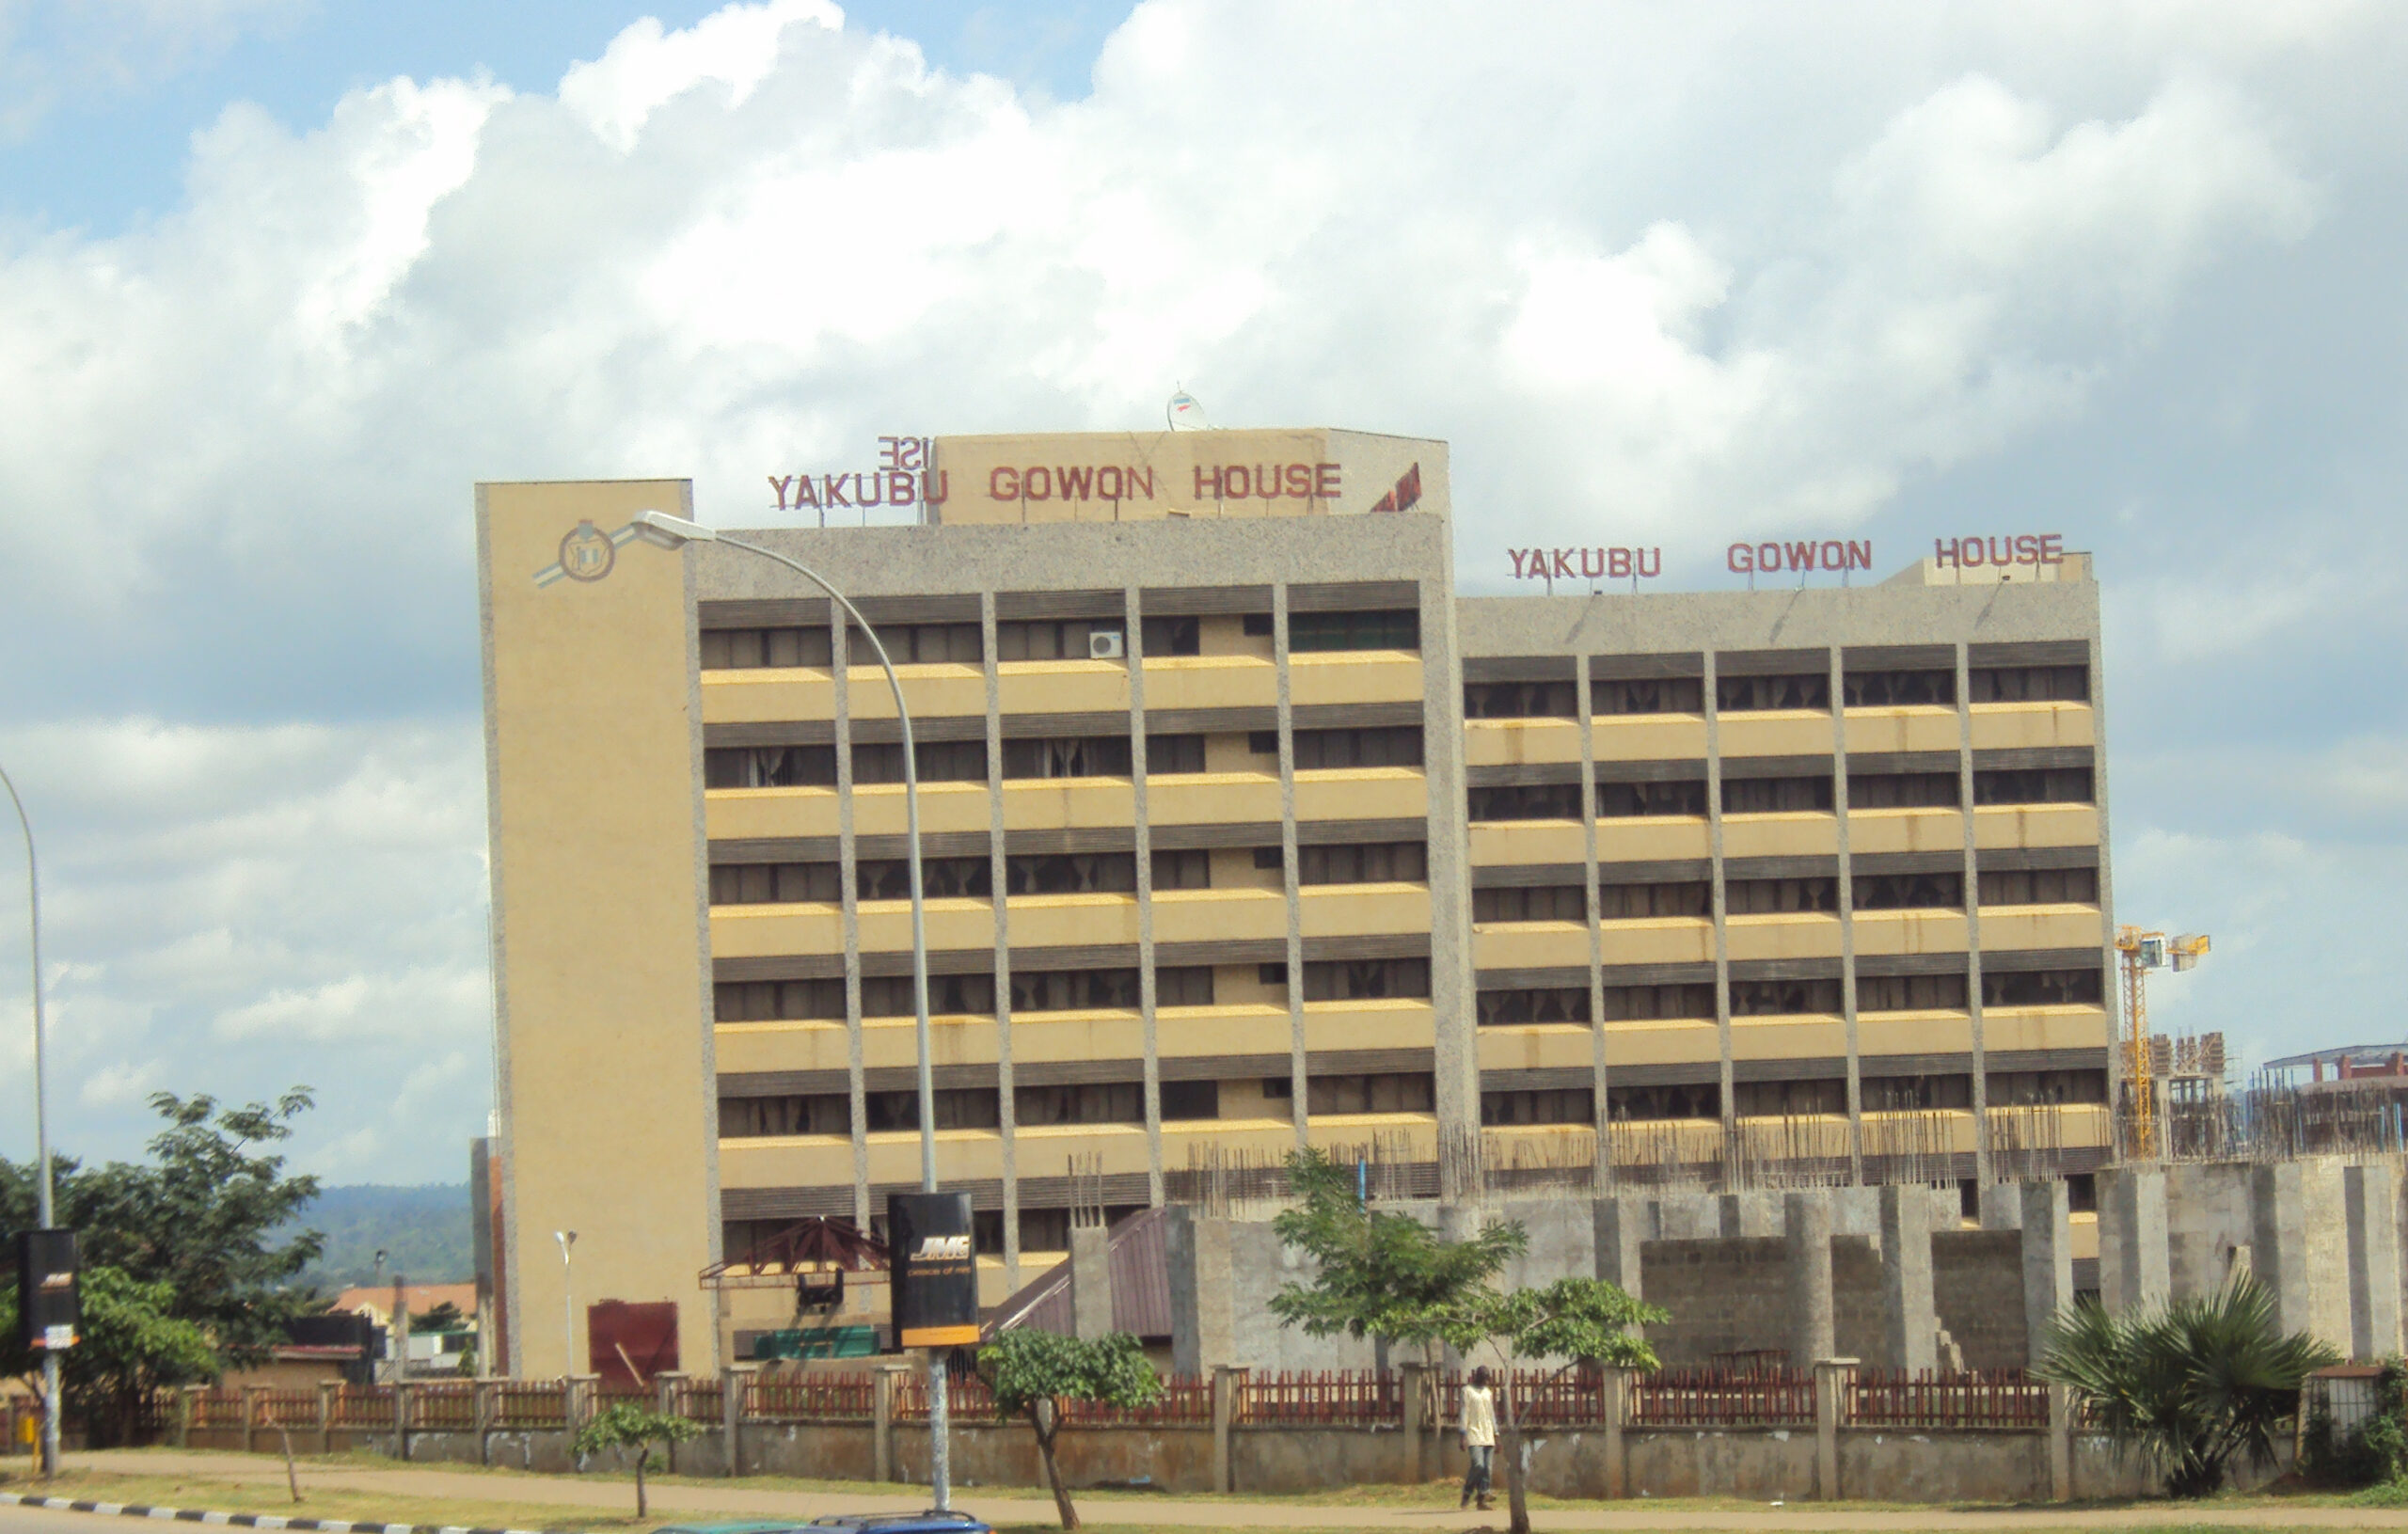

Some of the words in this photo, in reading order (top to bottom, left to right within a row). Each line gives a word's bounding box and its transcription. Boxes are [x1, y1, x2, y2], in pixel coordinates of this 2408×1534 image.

[768, 469, 948, 511] YAKUBU
[990, 466, 1154, 501] GOWON
[1194, 463, 1341, 500] HOUSE
[1508, 547, 1660, 579] YAKUBU
[1728, 540, 1871, 573] GOWON
[1935, 533, 2063, 568] HOUSE
[910, 1235, 971, 1261] JMG
